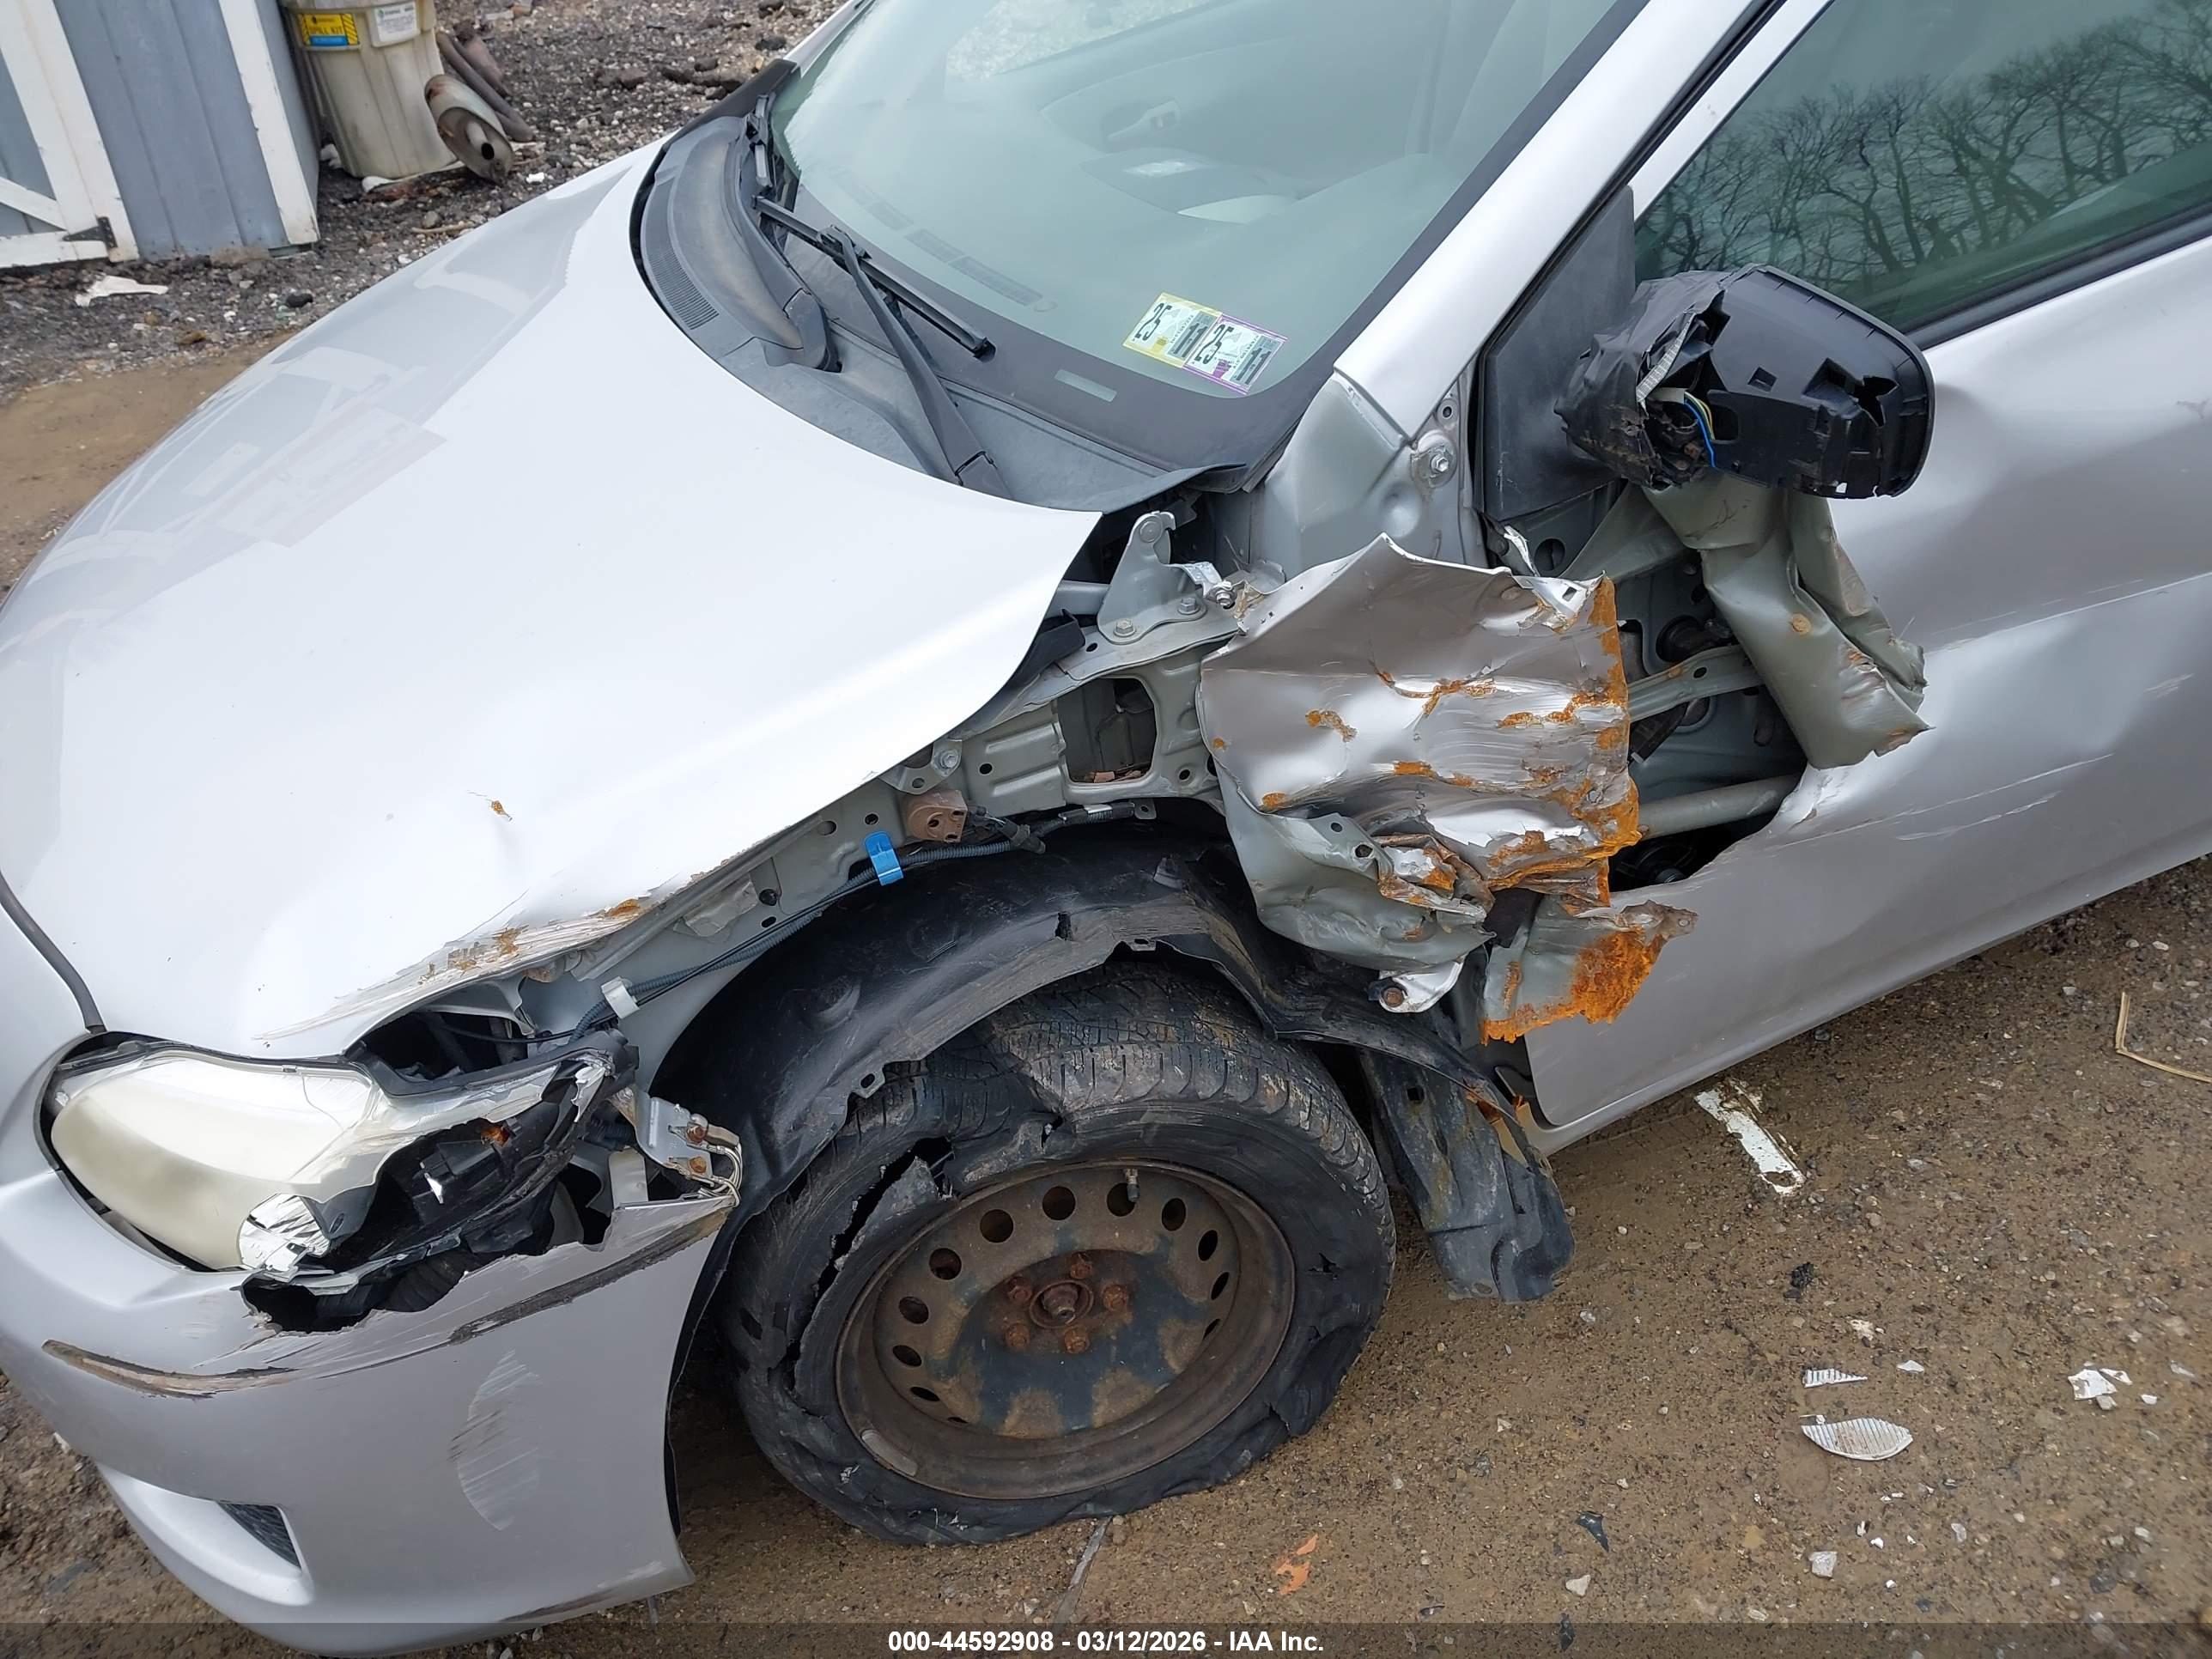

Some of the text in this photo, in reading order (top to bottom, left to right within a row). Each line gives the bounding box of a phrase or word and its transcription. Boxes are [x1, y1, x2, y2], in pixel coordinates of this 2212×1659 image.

[1134, 302, 1173, 341] 25
[1172, 323, 1208, 357] 11
[1194, 324, 1235, 365] 25
[1236, 348, 1272, 385] 11
